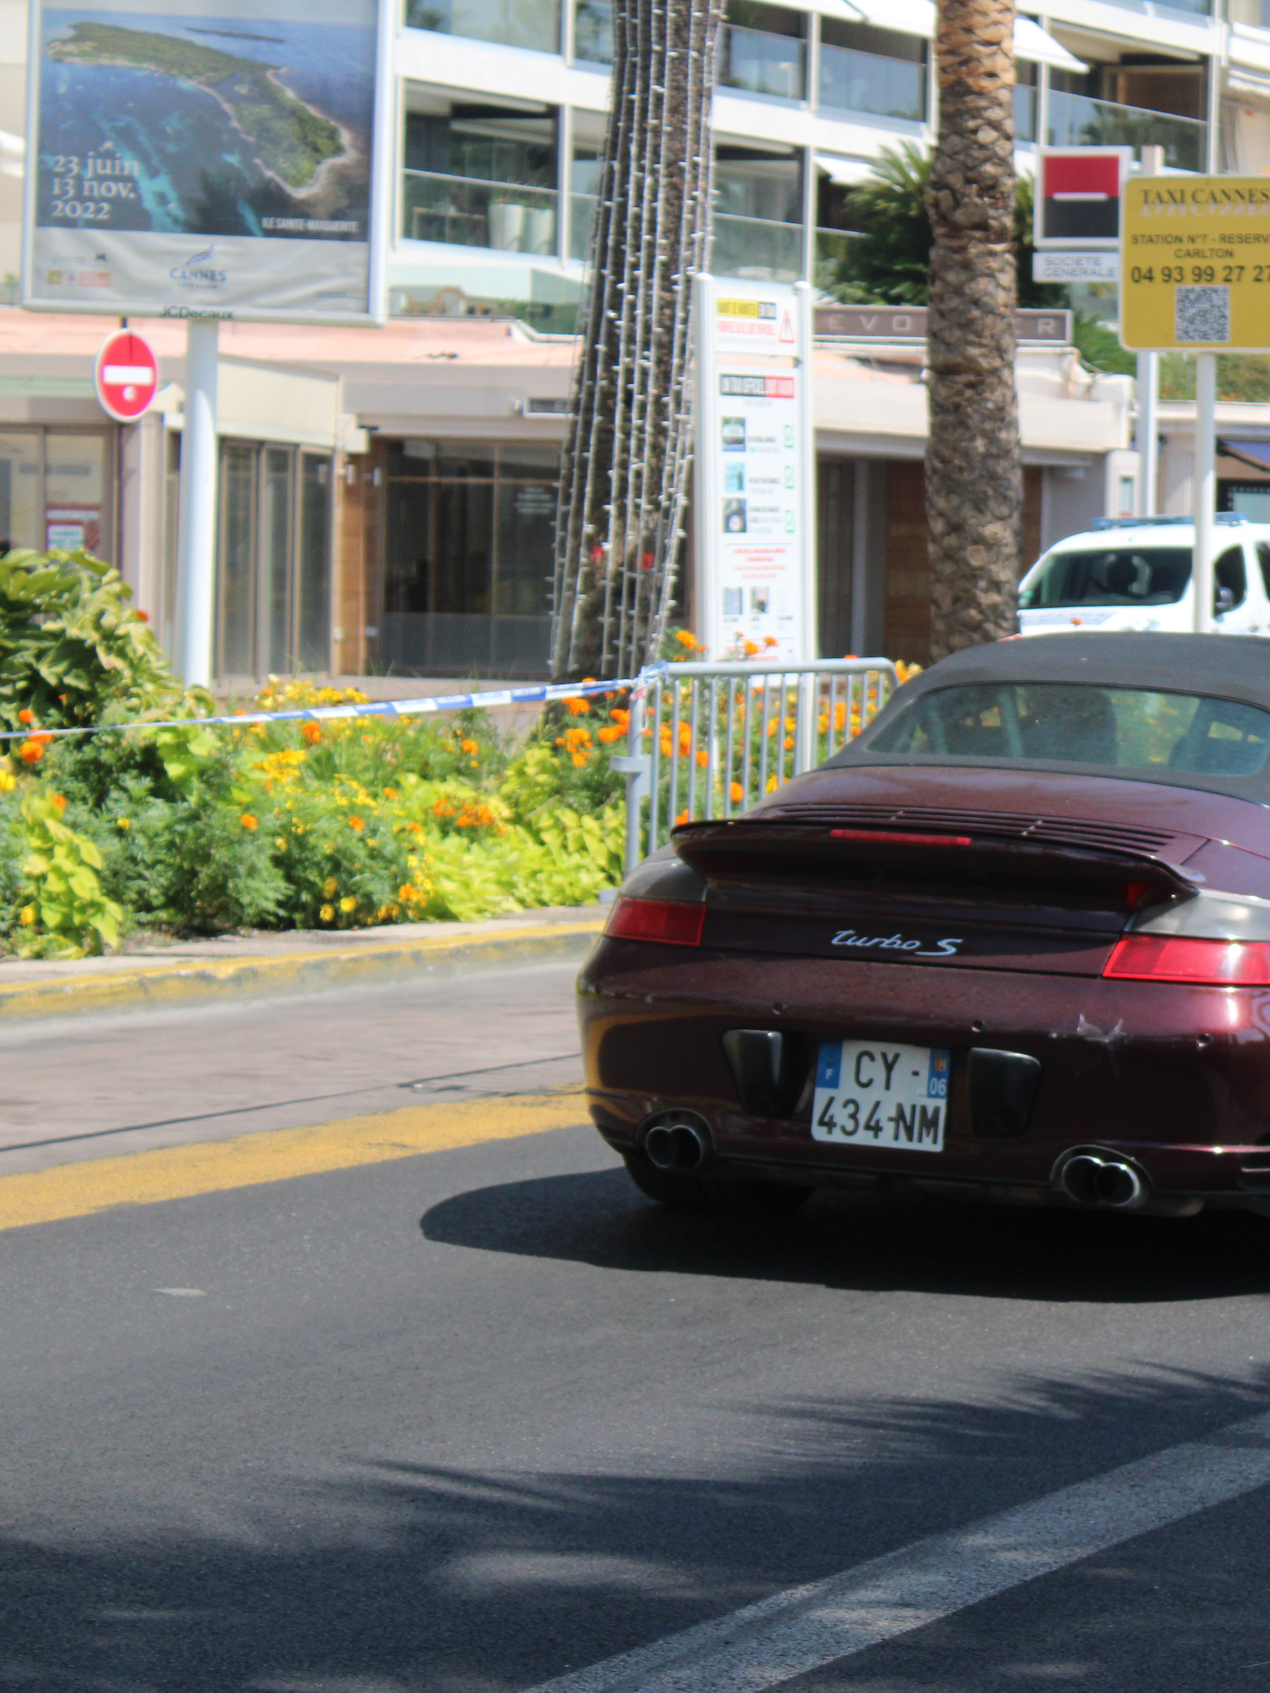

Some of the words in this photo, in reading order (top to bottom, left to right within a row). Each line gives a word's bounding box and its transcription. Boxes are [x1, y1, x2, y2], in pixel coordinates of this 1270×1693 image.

[52, 154, 79, 178] 23
[86, 151, 140, 181] juin
[52, 177, 76, 201] 13
[82, 179, 137, 200] nov.
[1140, 188, 1187, 206] TAXI
[1191, 187, 1270, 206] CANNES
[51, 201, 111, 221] 2022
[1130, 233, 1183, 245] STATION
[1174, 247, 1234, 259] CARLTON
[169, 267, 227, 282] CANNES
[1130, 266, 1154, 283] 04
[1161, 266, 1184, 282] 93
[1191, 266, 1215, 282] 99
[1222, 265, 1246, 282] 27
[159, 304, 235, 320] JCDecaux
[831, 929, 921, 950] turbo
[914, 938, 963, 956] S
[824, 1068, 833, 1080] F
[853, 1049, 900, 1091] CY
[929, 1077, 947, 1096] 06
[816, 1095, 941, 1145] 434-NM
